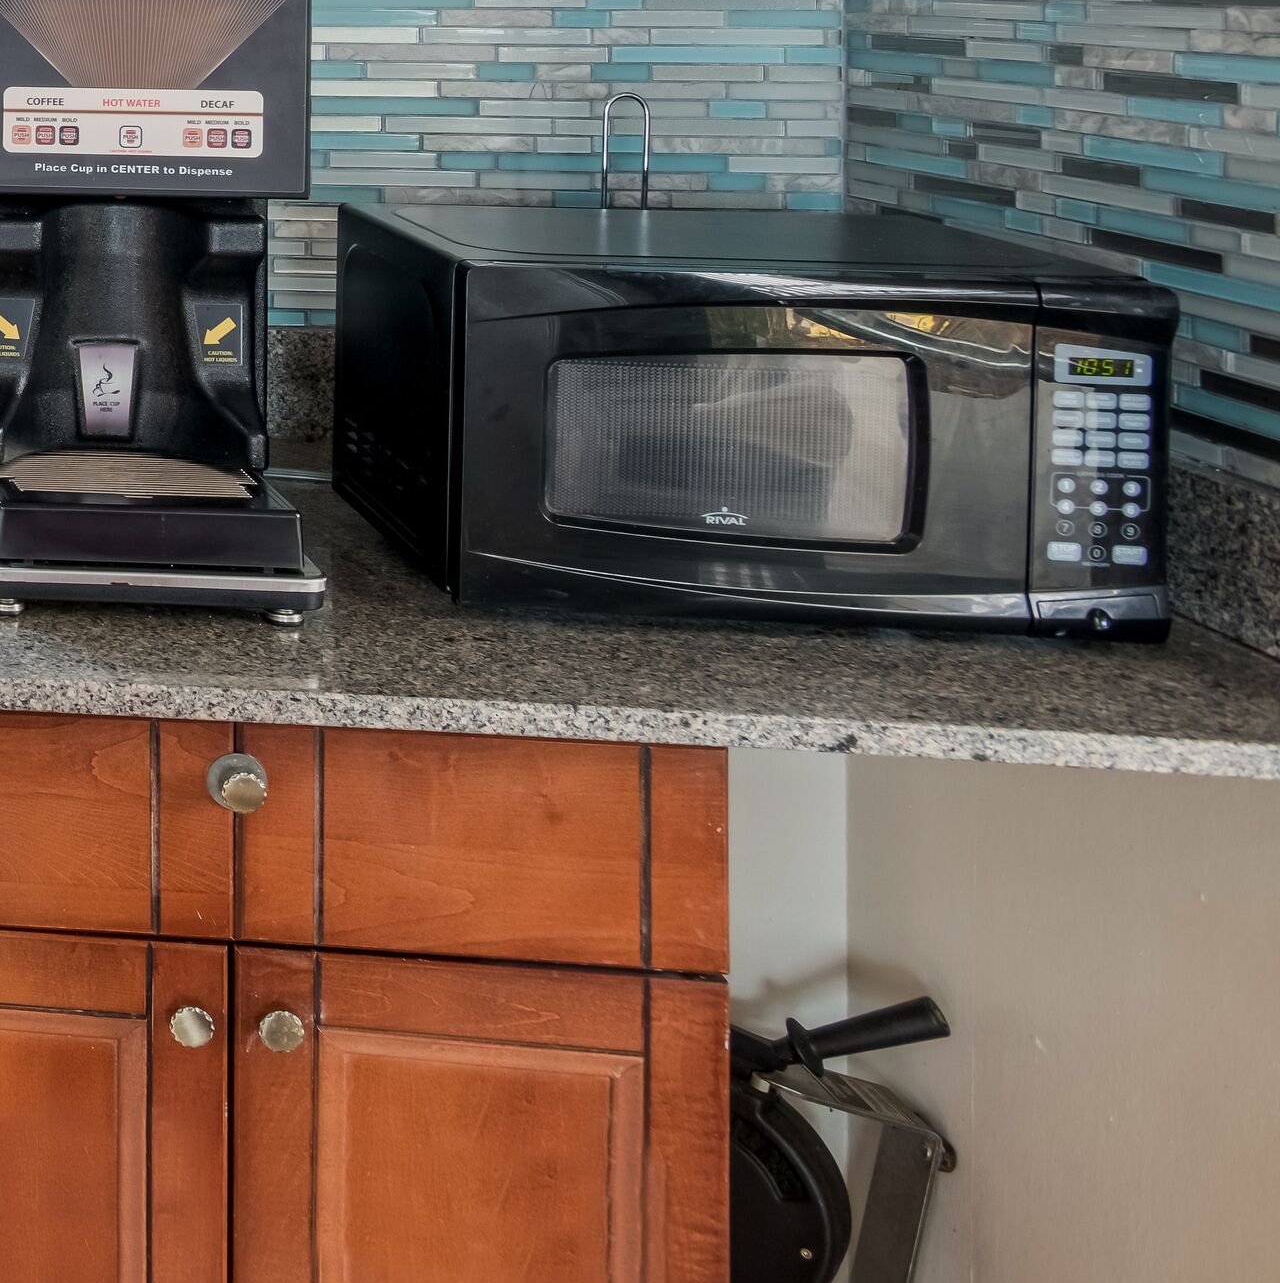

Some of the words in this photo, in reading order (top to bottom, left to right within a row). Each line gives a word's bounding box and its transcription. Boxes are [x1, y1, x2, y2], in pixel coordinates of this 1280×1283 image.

[26, 97, 64, 106] COFFEE
[102, 99, 123, 107] HOT
[127, 99, 161, 108] WATER
[200, 100, 235, 109] DECAF
[34, 162, 67, 172] Place
[70, 163, 93, 175] Cup
[96, 164, 108, 173] in
[110, 164, 160, 174] CENTER
[163, 166, 176, 175] to
[179, 166, 233, 177] Dispense
[705, 516, 747, 526] RIVAL
[1051, 543, 1078, 552] STOP
[1115, 546, 1143, 555] START
[1092, 549, 1101, 558] 0
